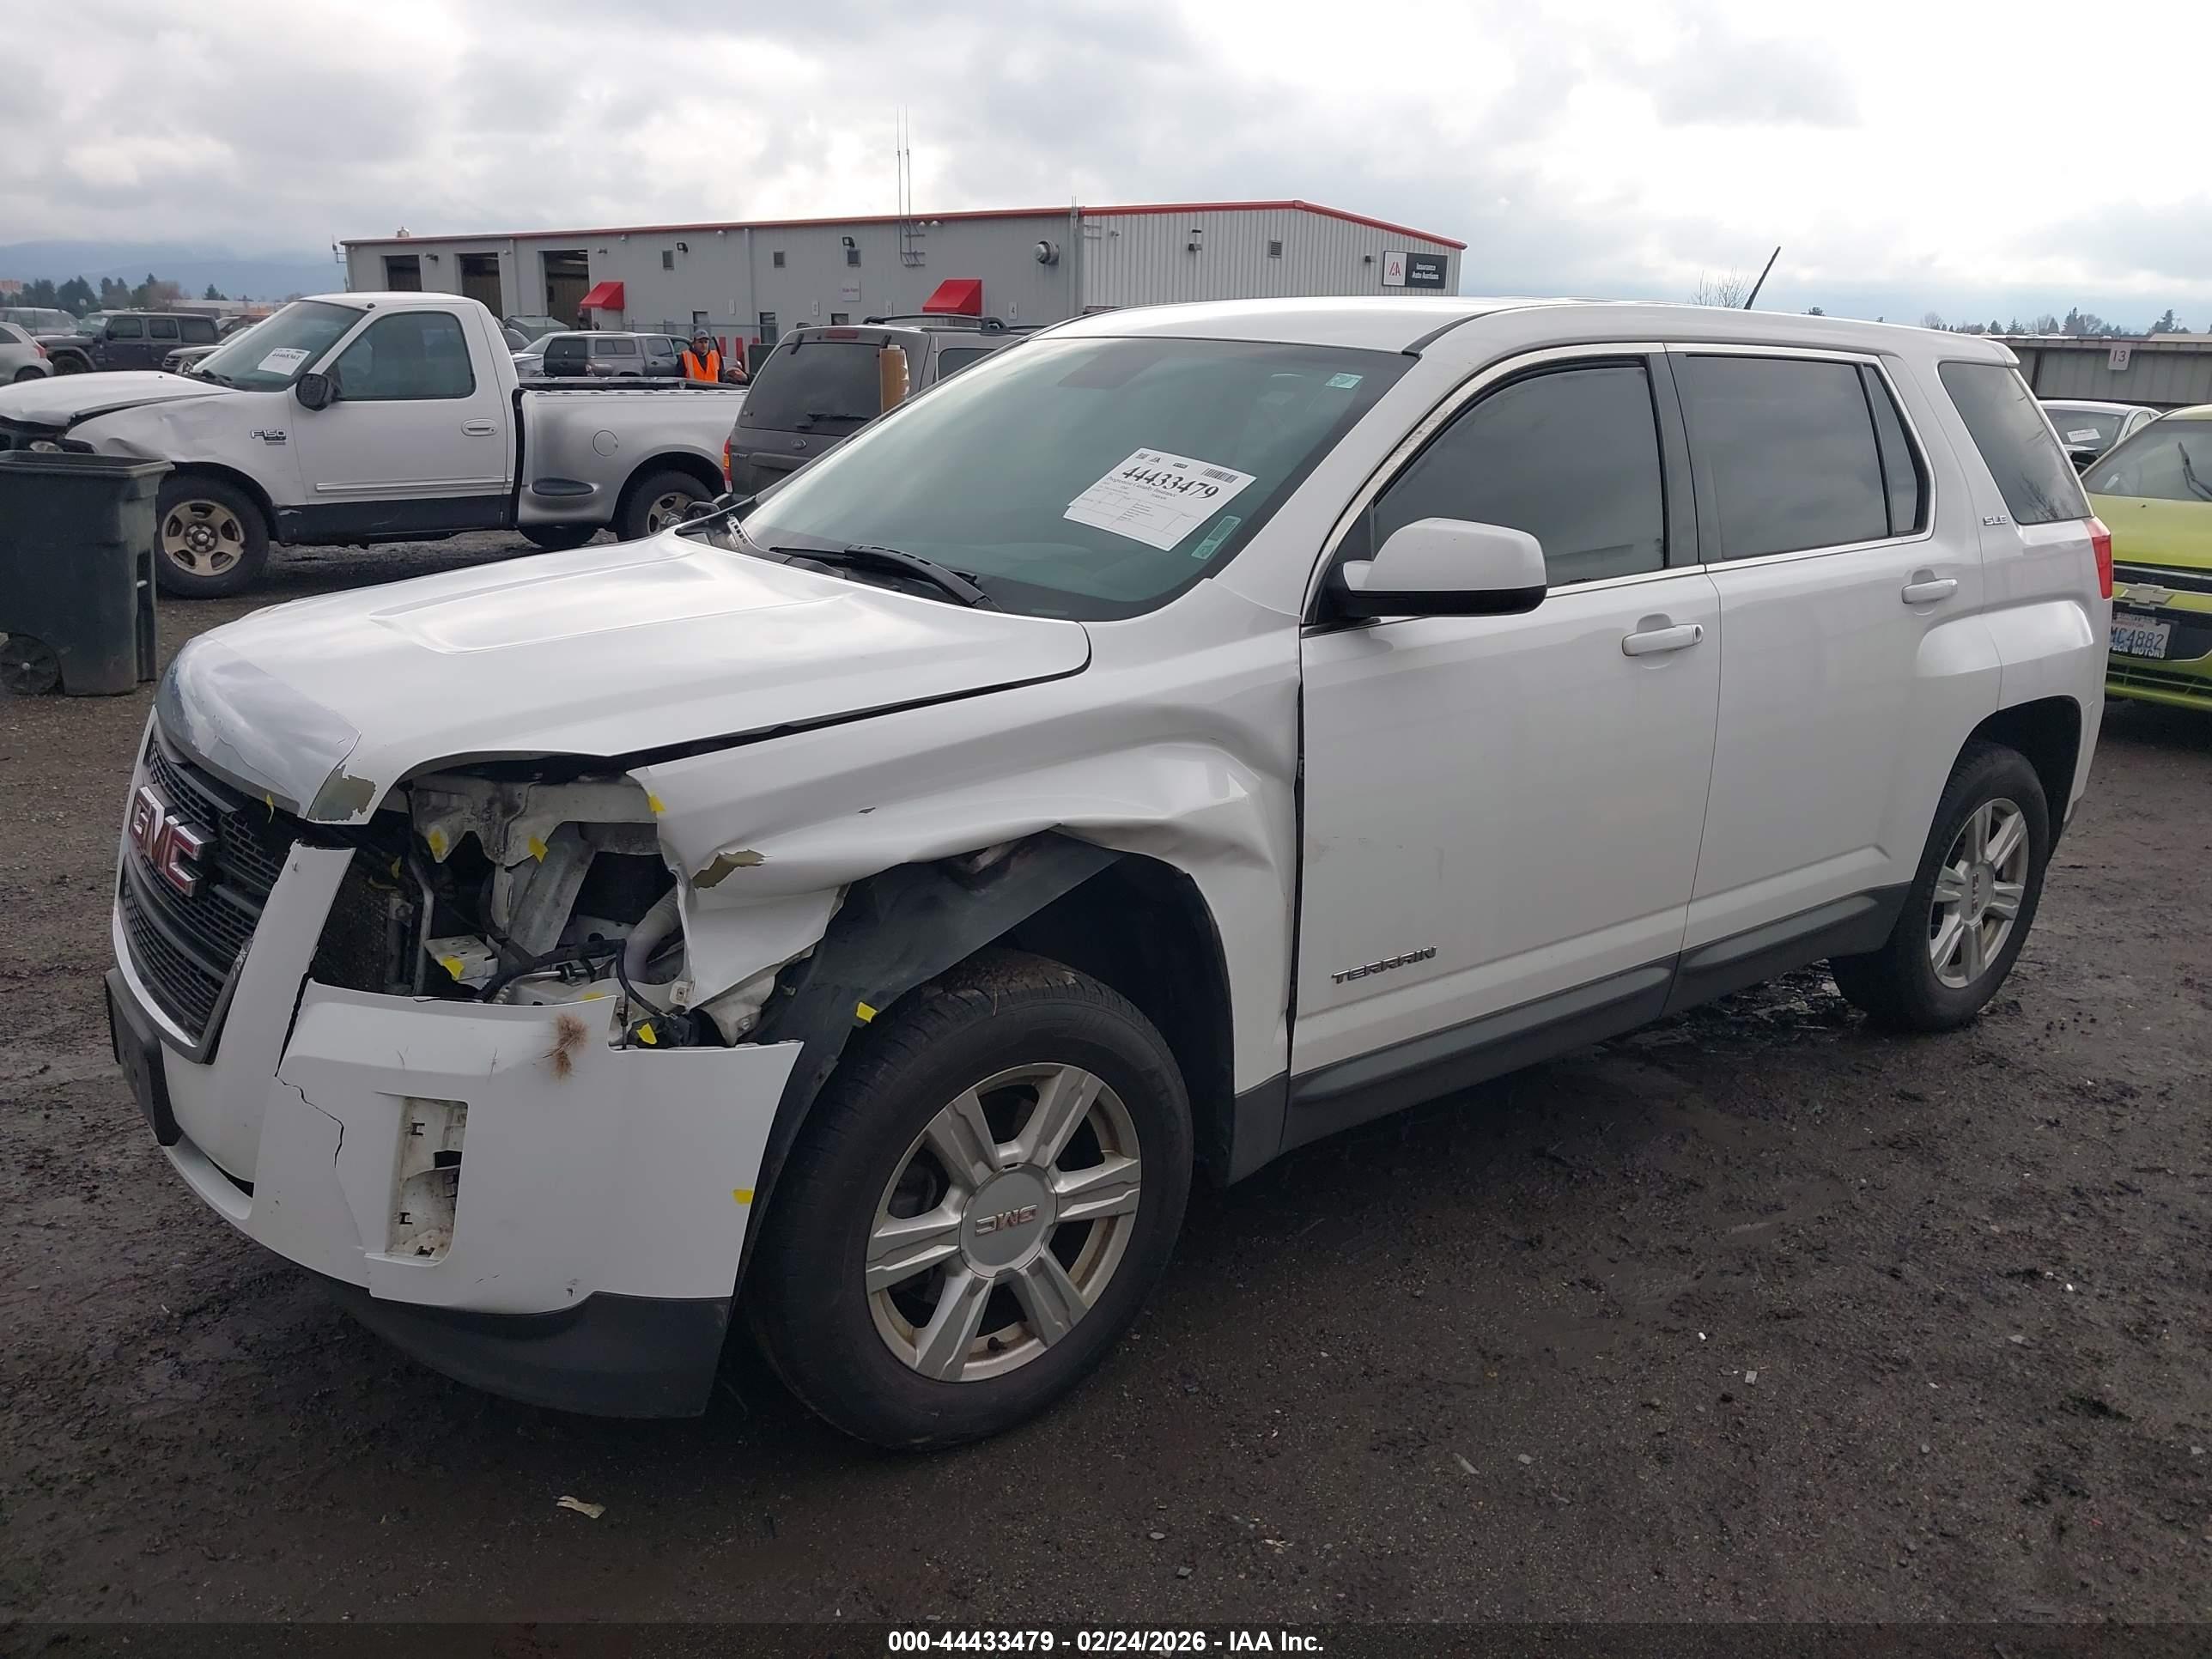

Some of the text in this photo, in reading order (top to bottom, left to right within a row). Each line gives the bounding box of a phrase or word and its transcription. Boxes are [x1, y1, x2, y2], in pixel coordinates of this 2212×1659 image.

[2112, 349, 2127, 362] 13
[1121, 466, 1219, 499] 44433479
[1983, 515, 2008, 526] SLE
[129, 786, 203, 898] GMC
[1331, 945, 1437, 984] TERRAIN
[975, 1204, 1037, 1237] GMC
